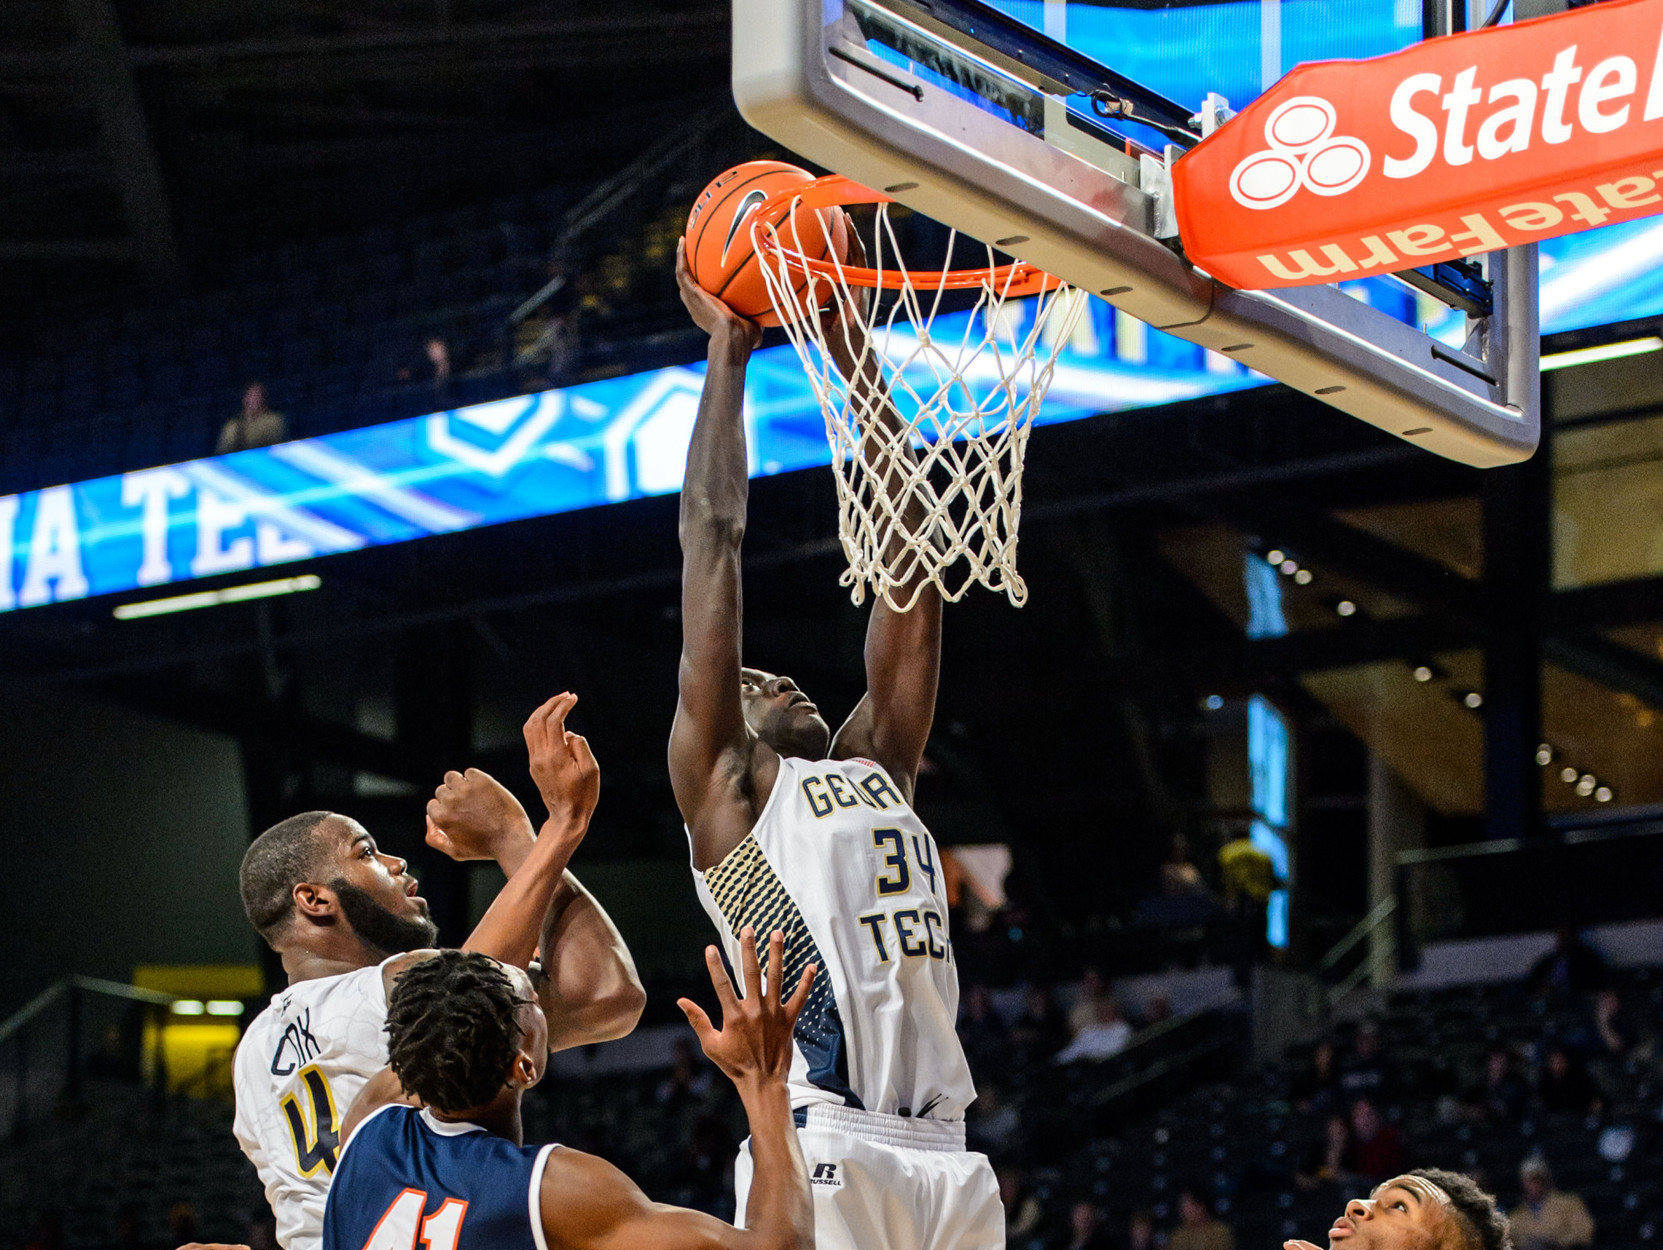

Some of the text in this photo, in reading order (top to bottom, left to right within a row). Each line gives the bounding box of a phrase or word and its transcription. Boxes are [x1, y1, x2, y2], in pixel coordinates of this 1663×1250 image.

[871, 827, 937, 897] 34
[859, 909, 953, 963] TEC
[280, 1063, 341, 1180] 4
